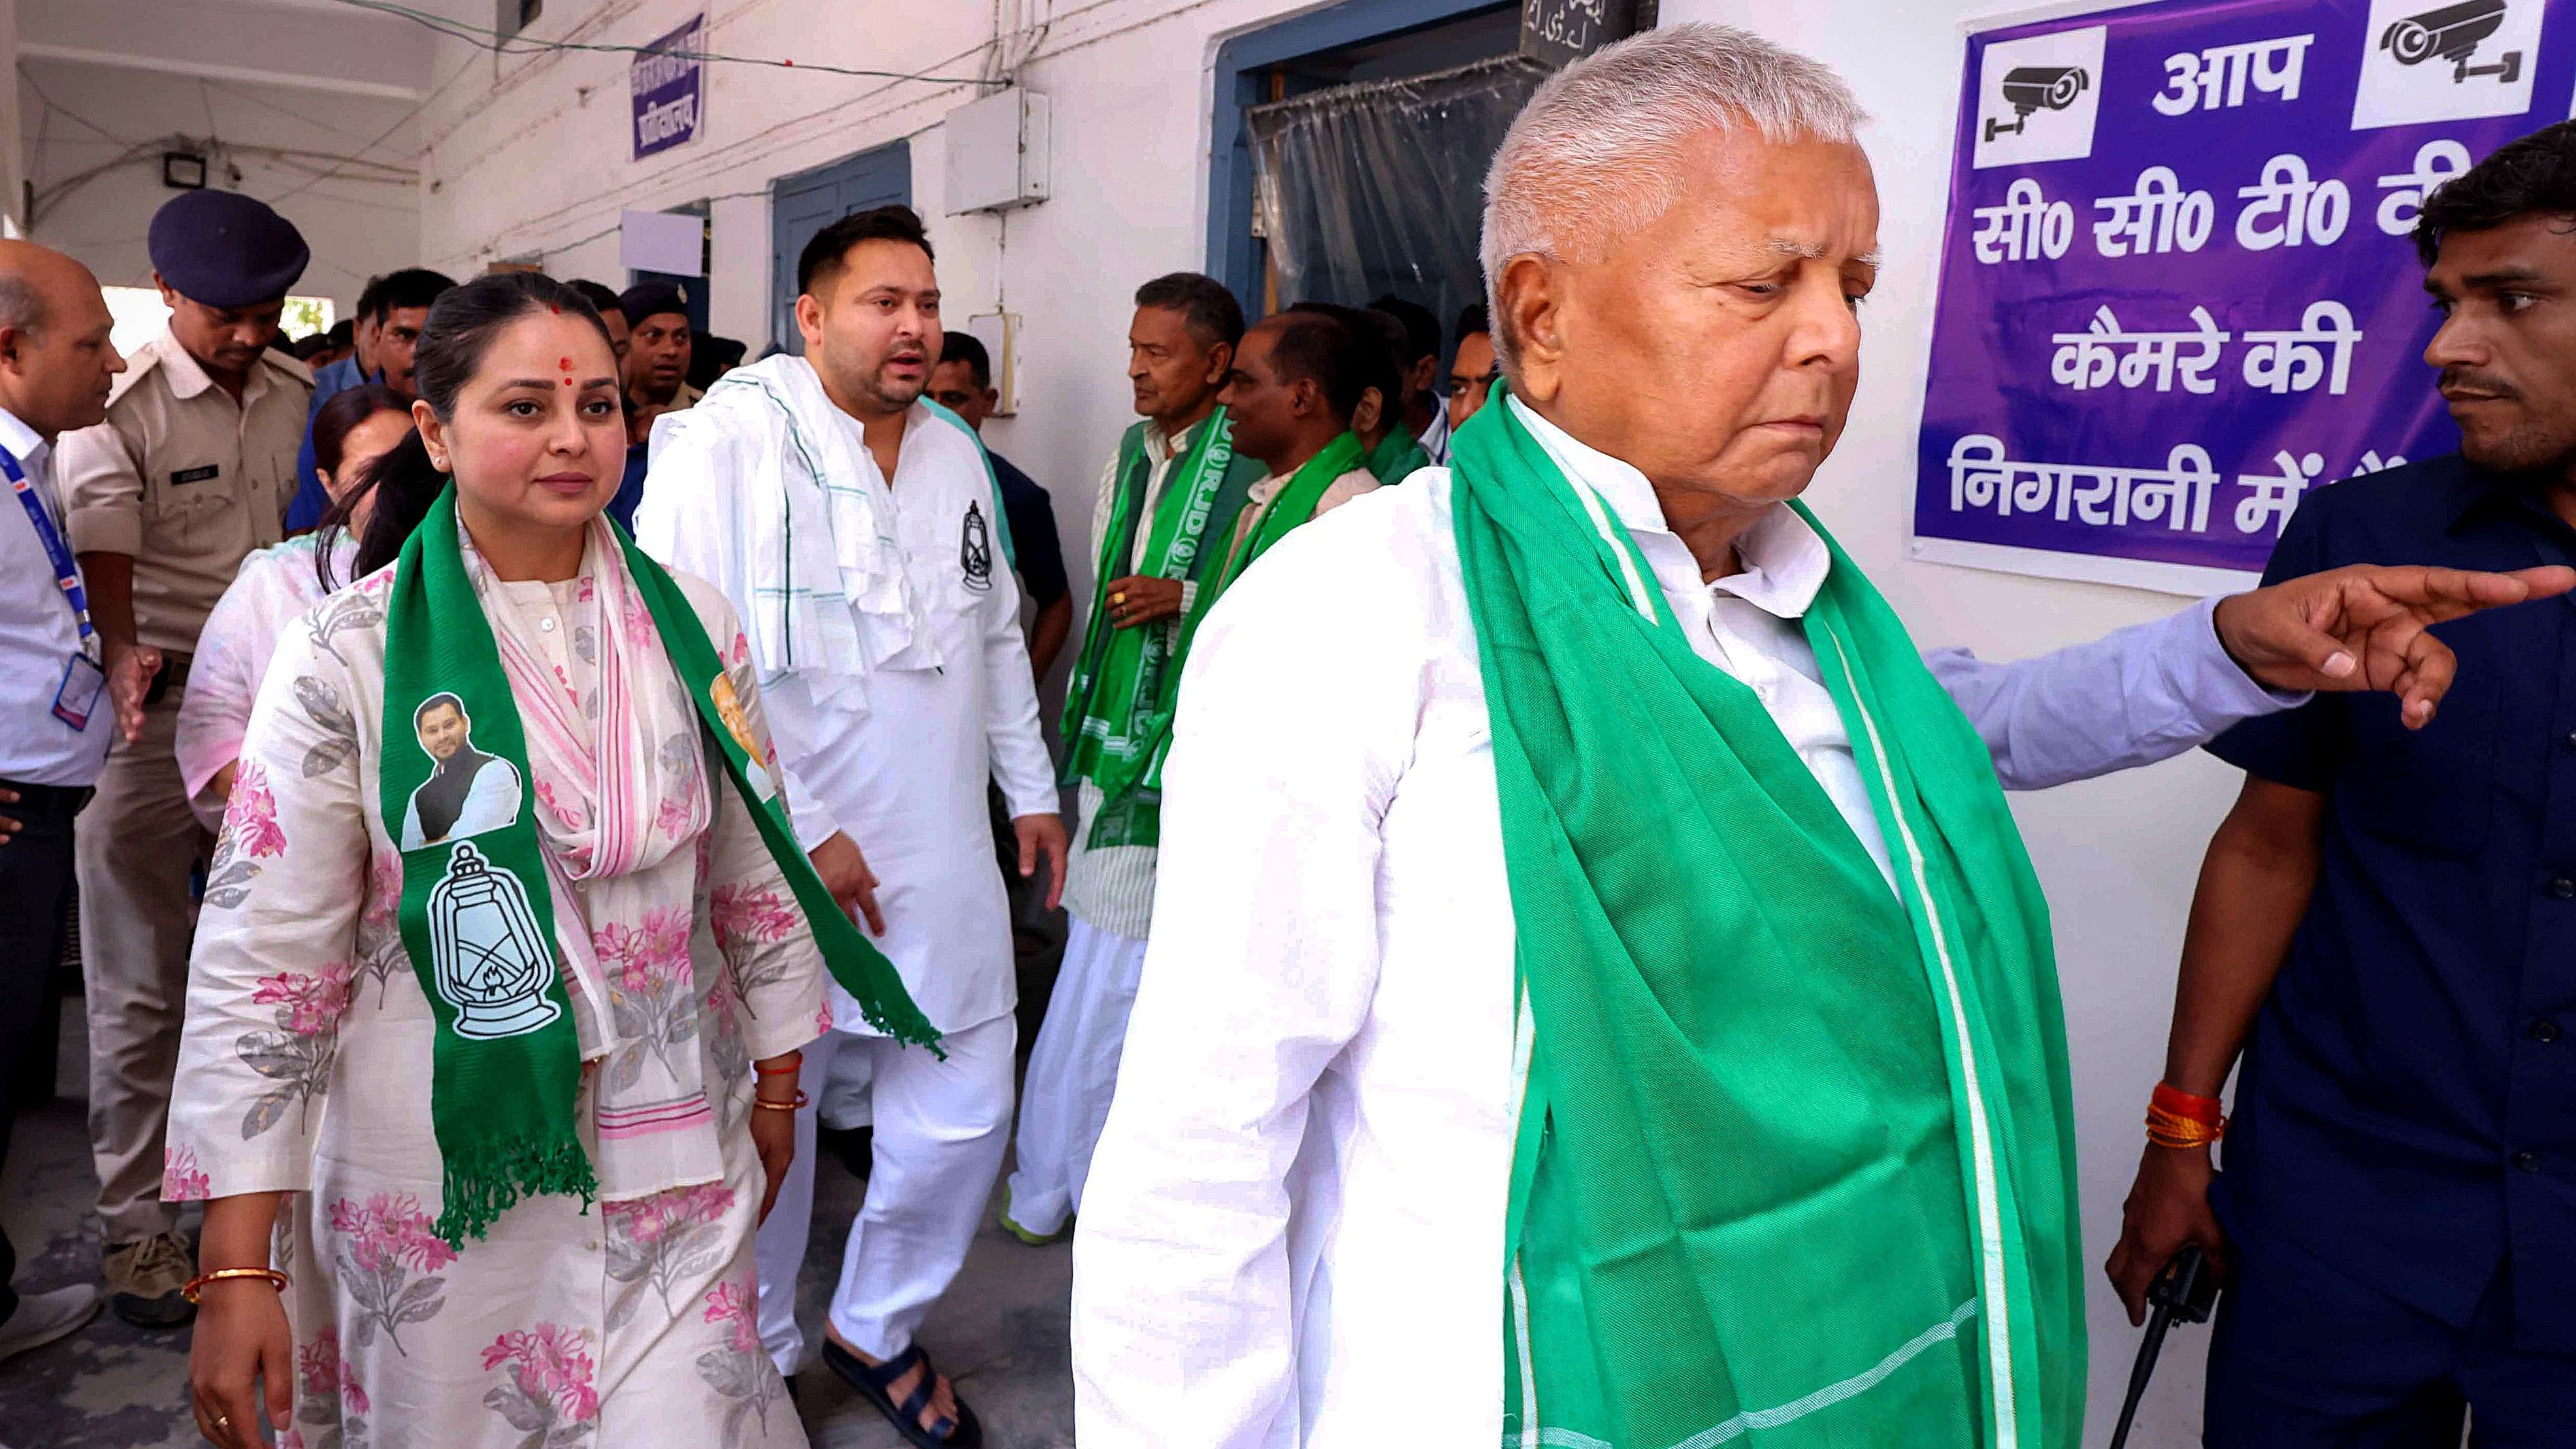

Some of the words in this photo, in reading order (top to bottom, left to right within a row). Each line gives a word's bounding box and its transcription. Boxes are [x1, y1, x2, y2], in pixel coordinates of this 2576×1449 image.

[2153, 33, 2315, 116] आप
[2051, 304, 2230, 395] कैमरे
[2243, 301, 2363, 395] की
[1186, 469, 1224, 536] RJD
[1947, 434, 2221, 532] निगरानी
